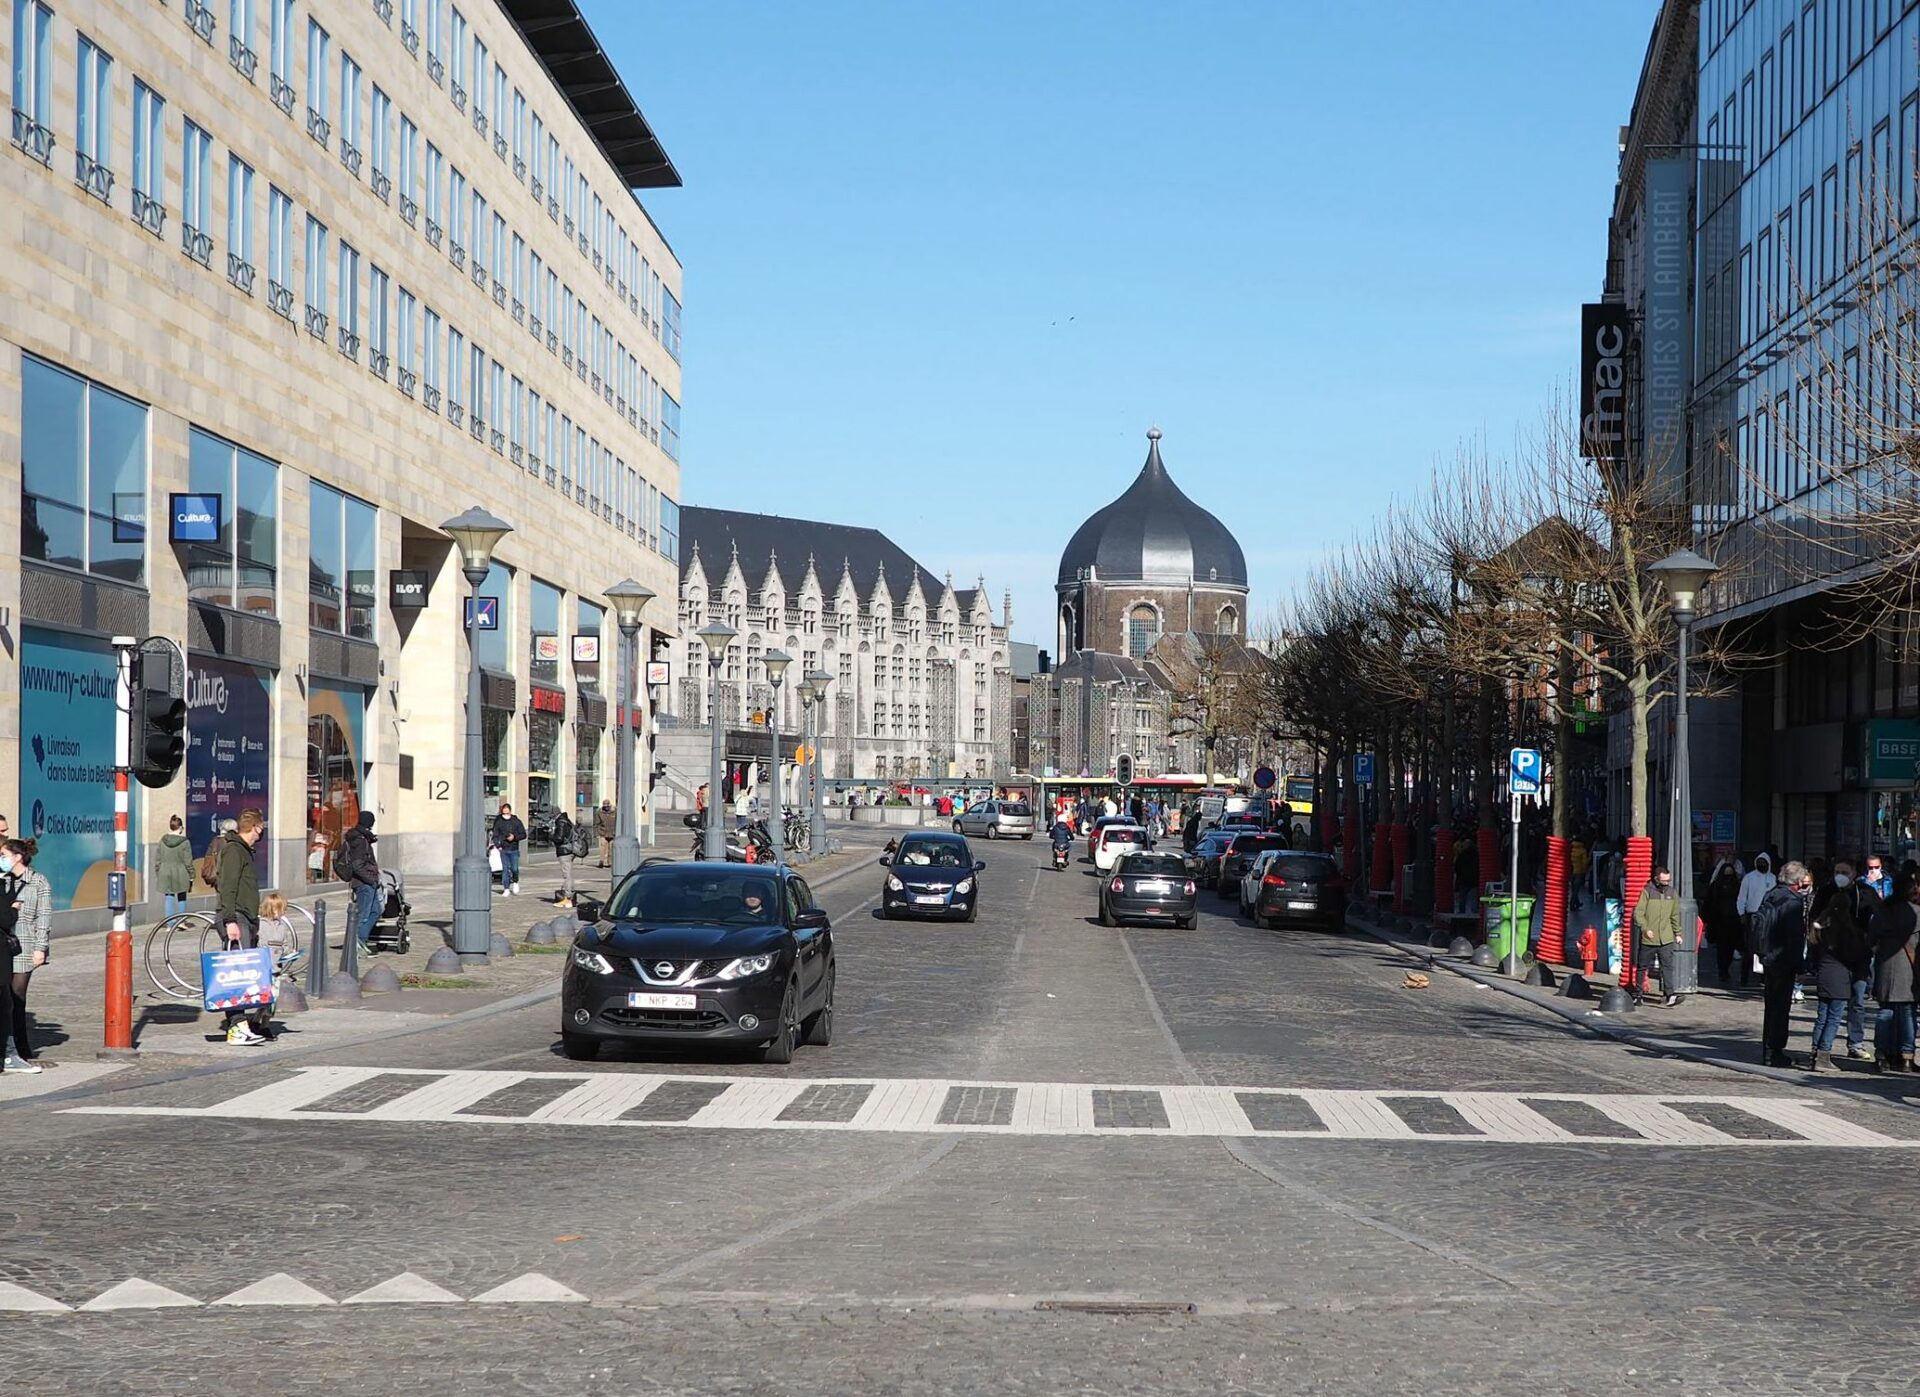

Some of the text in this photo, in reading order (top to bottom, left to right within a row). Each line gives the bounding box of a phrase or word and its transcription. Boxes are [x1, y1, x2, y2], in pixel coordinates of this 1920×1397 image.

[1652, 189, 1681, 446] GALERIES ST LAMBERT
[1584, 324, 1624, 441] fnac
[177, 512, 215, 525] Cultura
[186, 668, 229, 714] Cultura
[47, 735, 80, 757] Livraison
[1881, 743, 1918, 755] BASE
[47, 762, 66, 781] dans
[67, 764, 87, 782] toute
[87, 764, 94, 782] la
[1358, 757, 1368, 772] P
[1517, 752, 1535, 774] P
[429, 780, 450, 801] 12
[1514, 778, 1537, 791] taxis
[46, 814, 65, 835] Click
[66, 815, 72, 834] &
[72, 814, 98, 835] Collect
